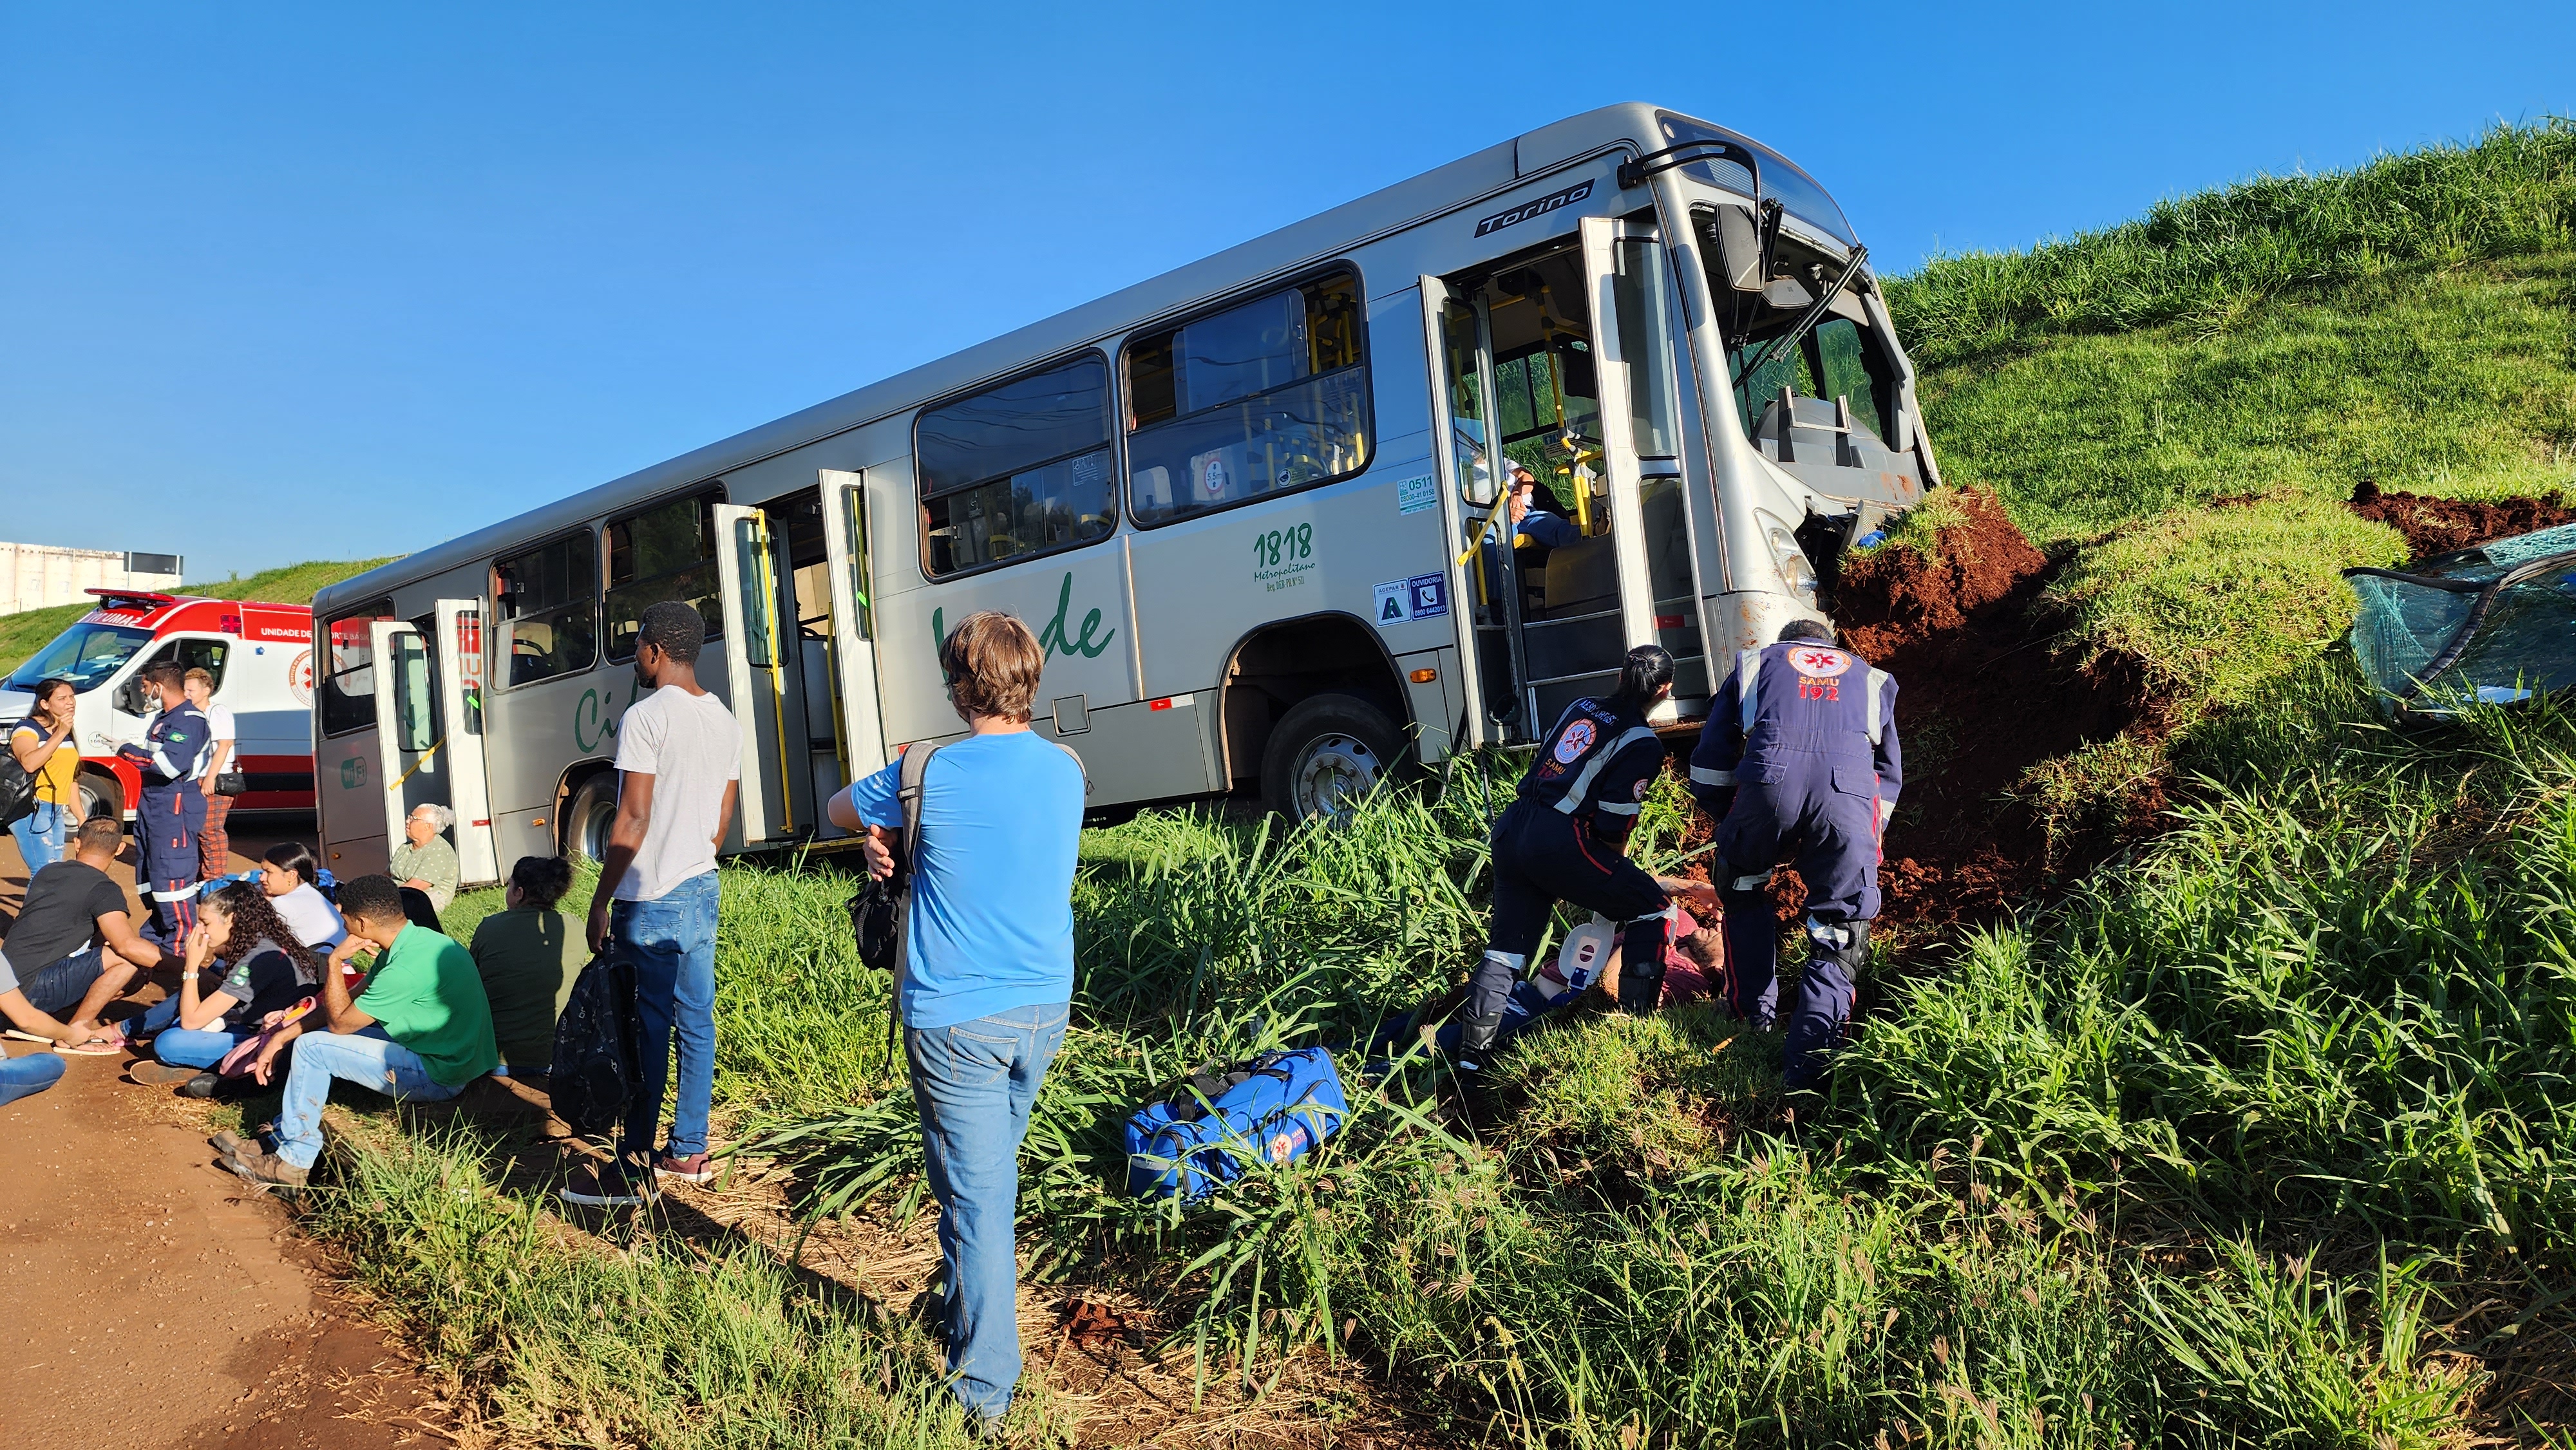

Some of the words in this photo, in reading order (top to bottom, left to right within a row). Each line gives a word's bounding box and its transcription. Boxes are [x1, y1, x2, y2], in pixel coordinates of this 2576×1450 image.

[1481, 187, 1589, 232] Torino
[1409, 475, 1432, 491] 0511
[1254, 522, 1312, 568] 1818
[1254, 563, 1316, 582] Metropolitano
[1379, 585, 1399, 593] AGEPAR
[1412, 576, 1443, 588] OUVIDORIA
[1426, 605, 1446, 614] 6442013
[261, 627, 299, 637] UNIDADE
[1799, 676, 1839, 686] SAMU
[1799, 684, 1839, 701] 192
[1546, 758, 1566, 775] SAMU
